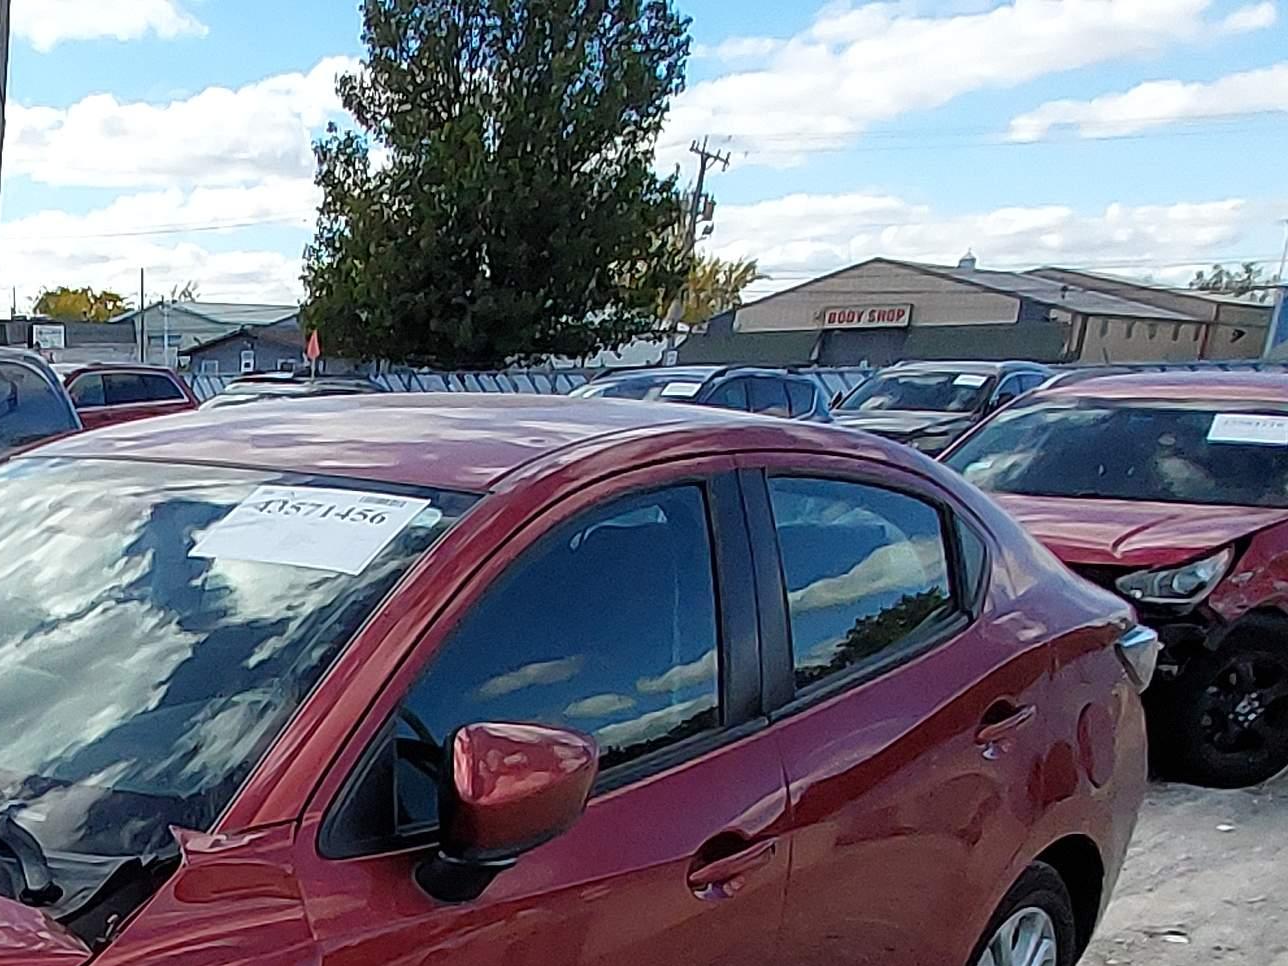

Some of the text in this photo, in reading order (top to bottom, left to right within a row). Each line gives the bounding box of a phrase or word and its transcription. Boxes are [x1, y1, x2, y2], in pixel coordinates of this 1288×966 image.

[828, 308, 905, 324] BODY SHOP
[254, 498, 390, 525] 43571456
